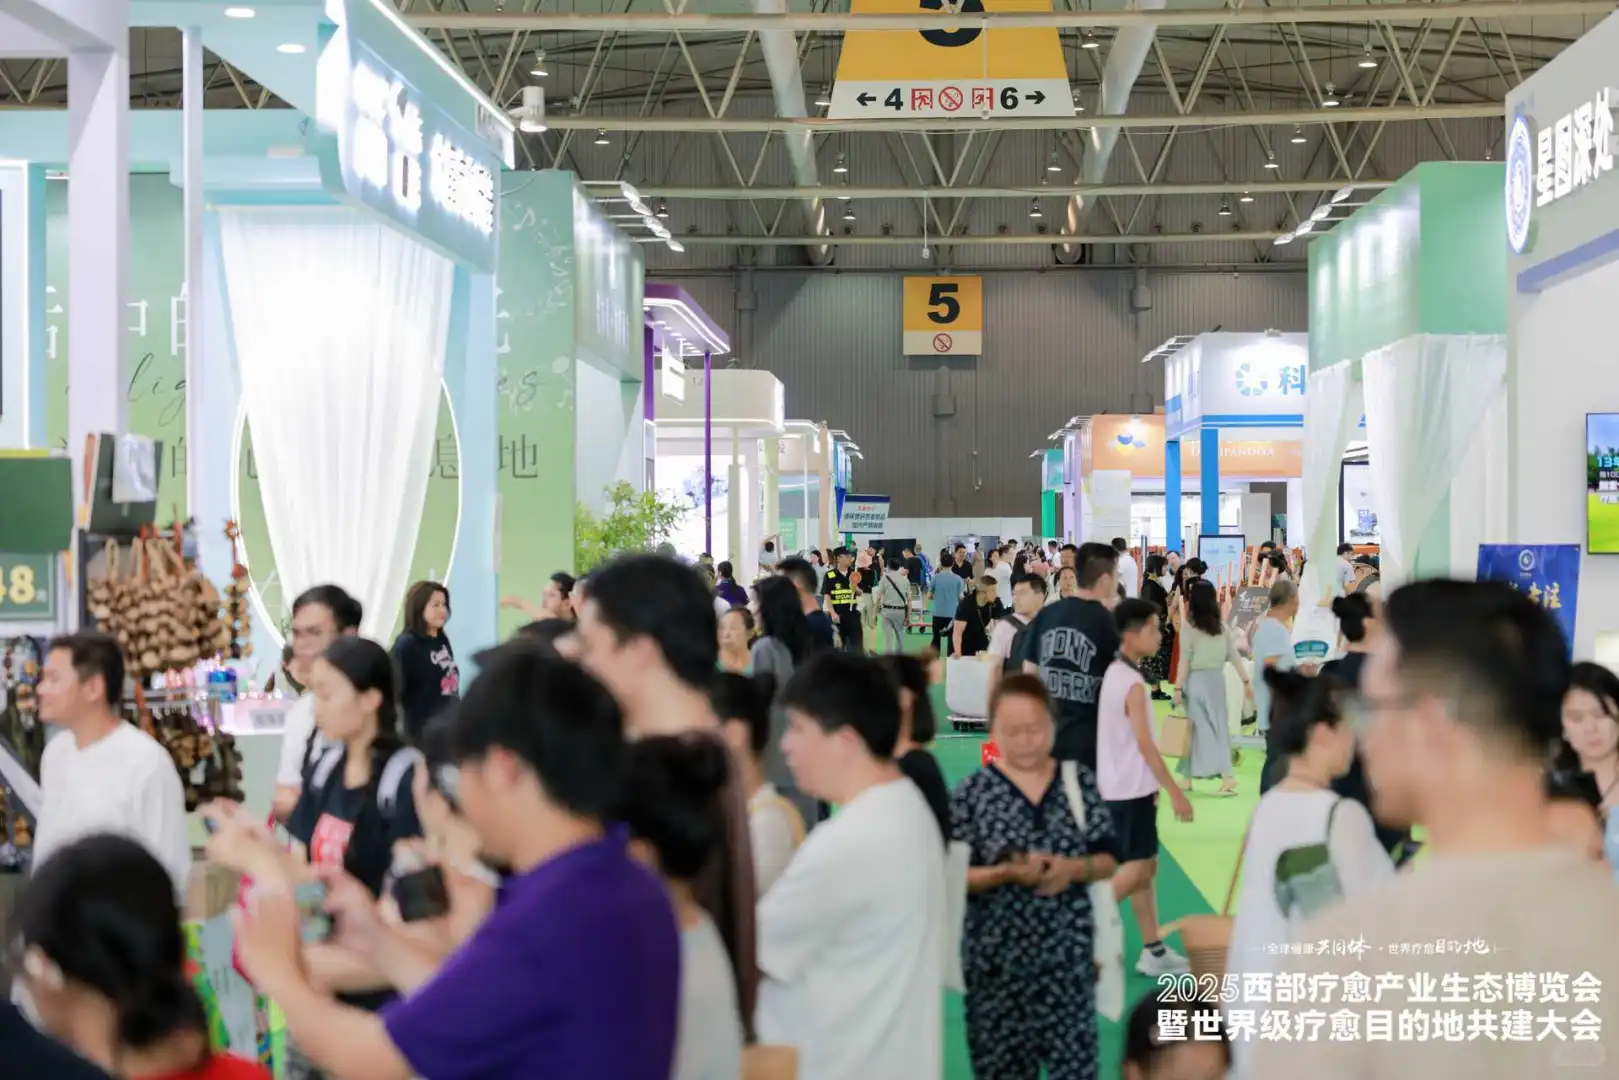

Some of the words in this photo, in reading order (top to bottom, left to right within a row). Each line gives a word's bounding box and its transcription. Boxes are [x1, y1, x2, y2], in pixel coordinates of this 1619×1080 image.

[884, 88, 904, 111] 4
[1000, 87, 1019, 110] 6
[927, 283, 960, 324] 5
[0, 564, 35, 605] 8
[1039, 667, 1104, 703] ORRY
